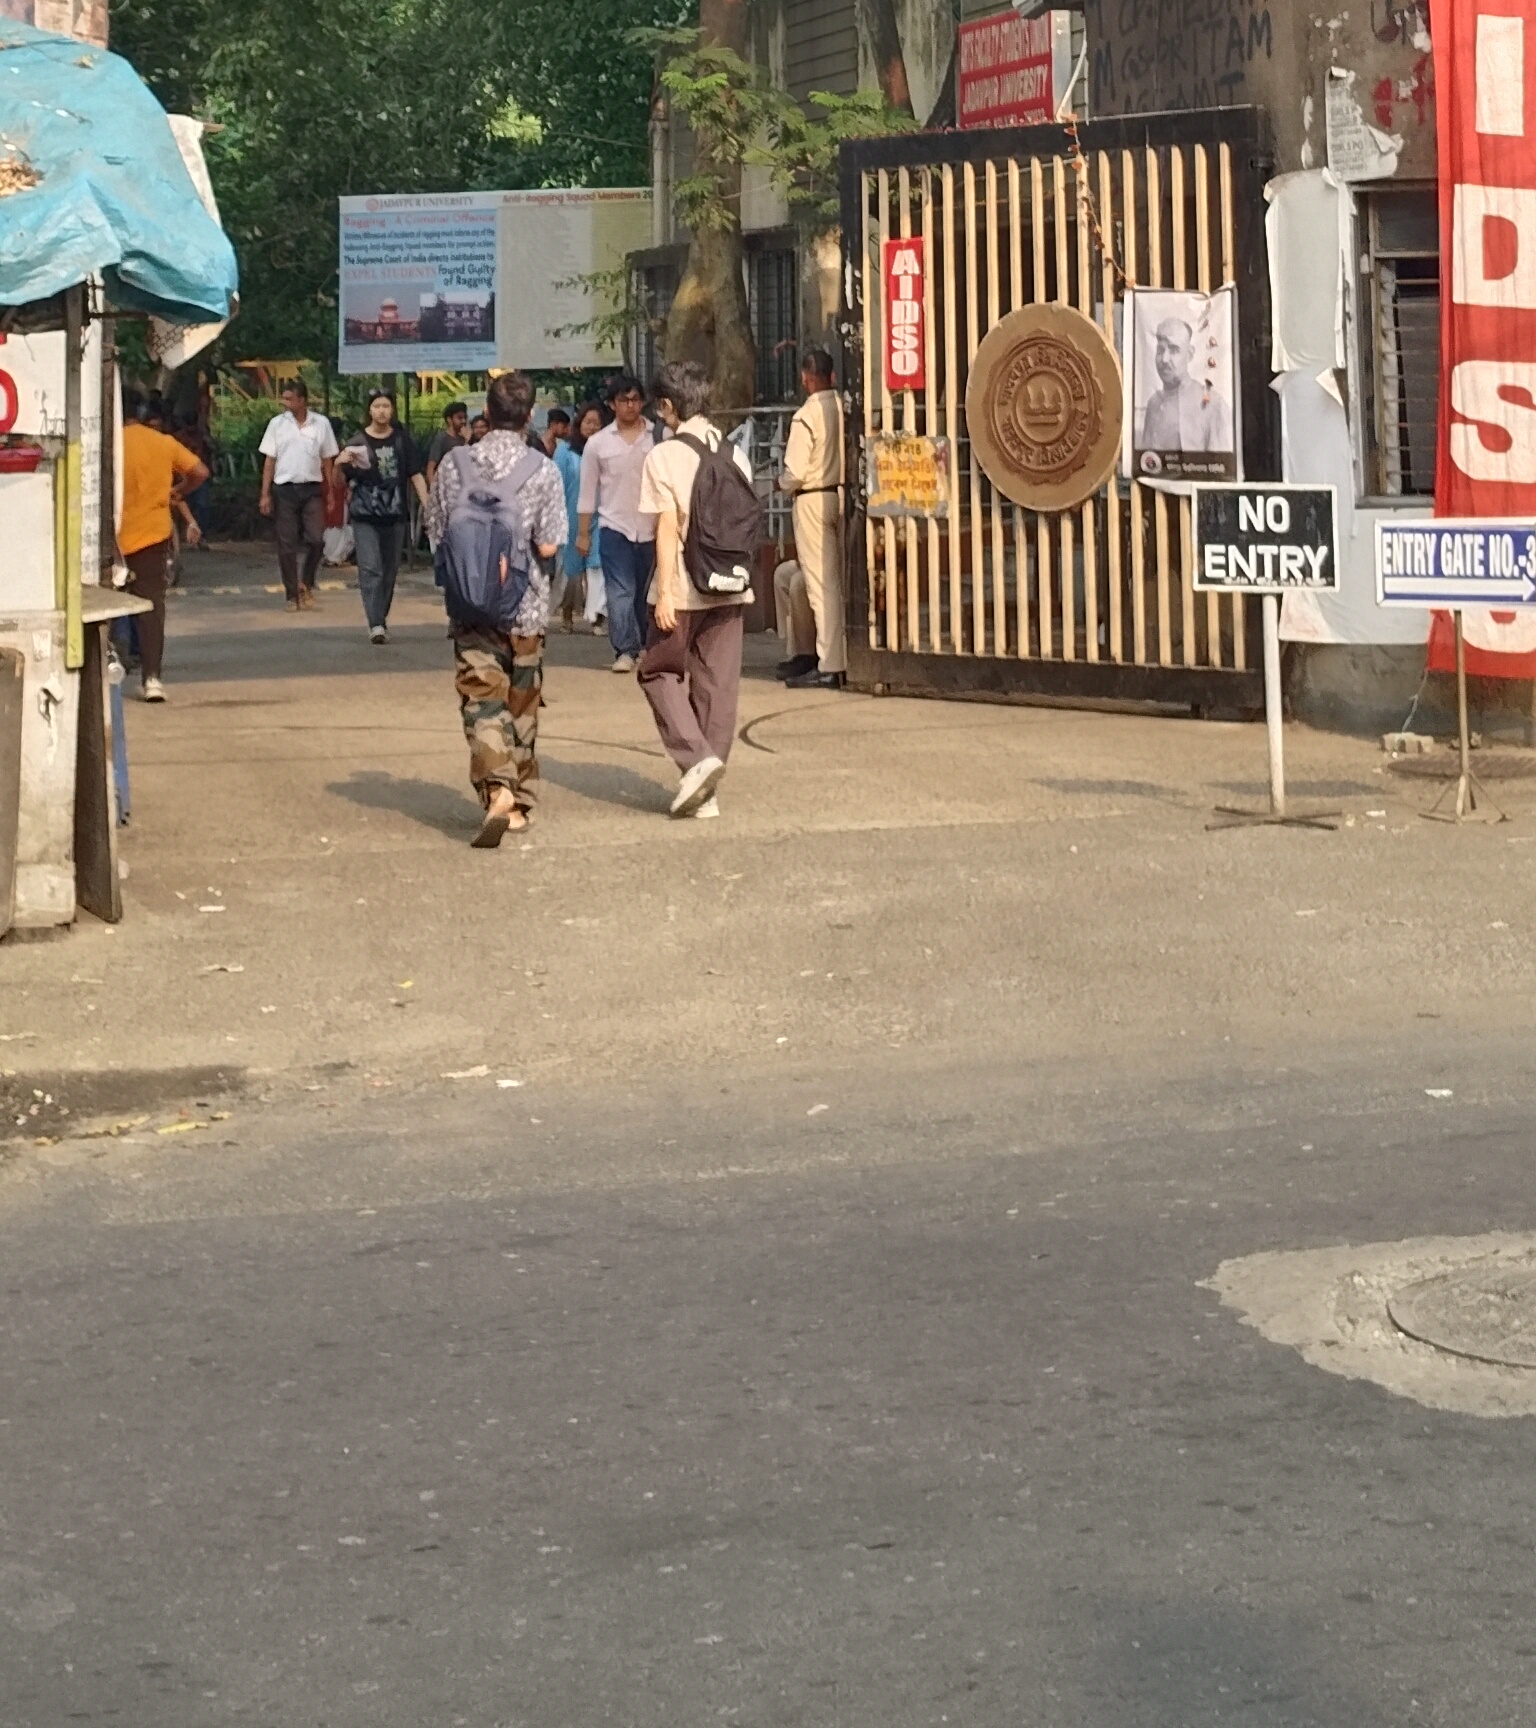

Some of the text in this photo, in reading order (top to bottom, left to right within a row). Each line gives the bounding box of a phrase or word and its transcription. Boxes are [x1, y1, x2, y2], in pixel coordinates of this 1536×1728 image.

[423, 195, 475, 208] UNIVERSITY
[890, 248, 921, 377] AIDSO
[1238, 494, 1291, 534] NO
[1204, 543, 1329, 583] ENTRY
[1382, 532, 1438, 576] ENTRY
[1440, 532, 1485, 577] GATE
